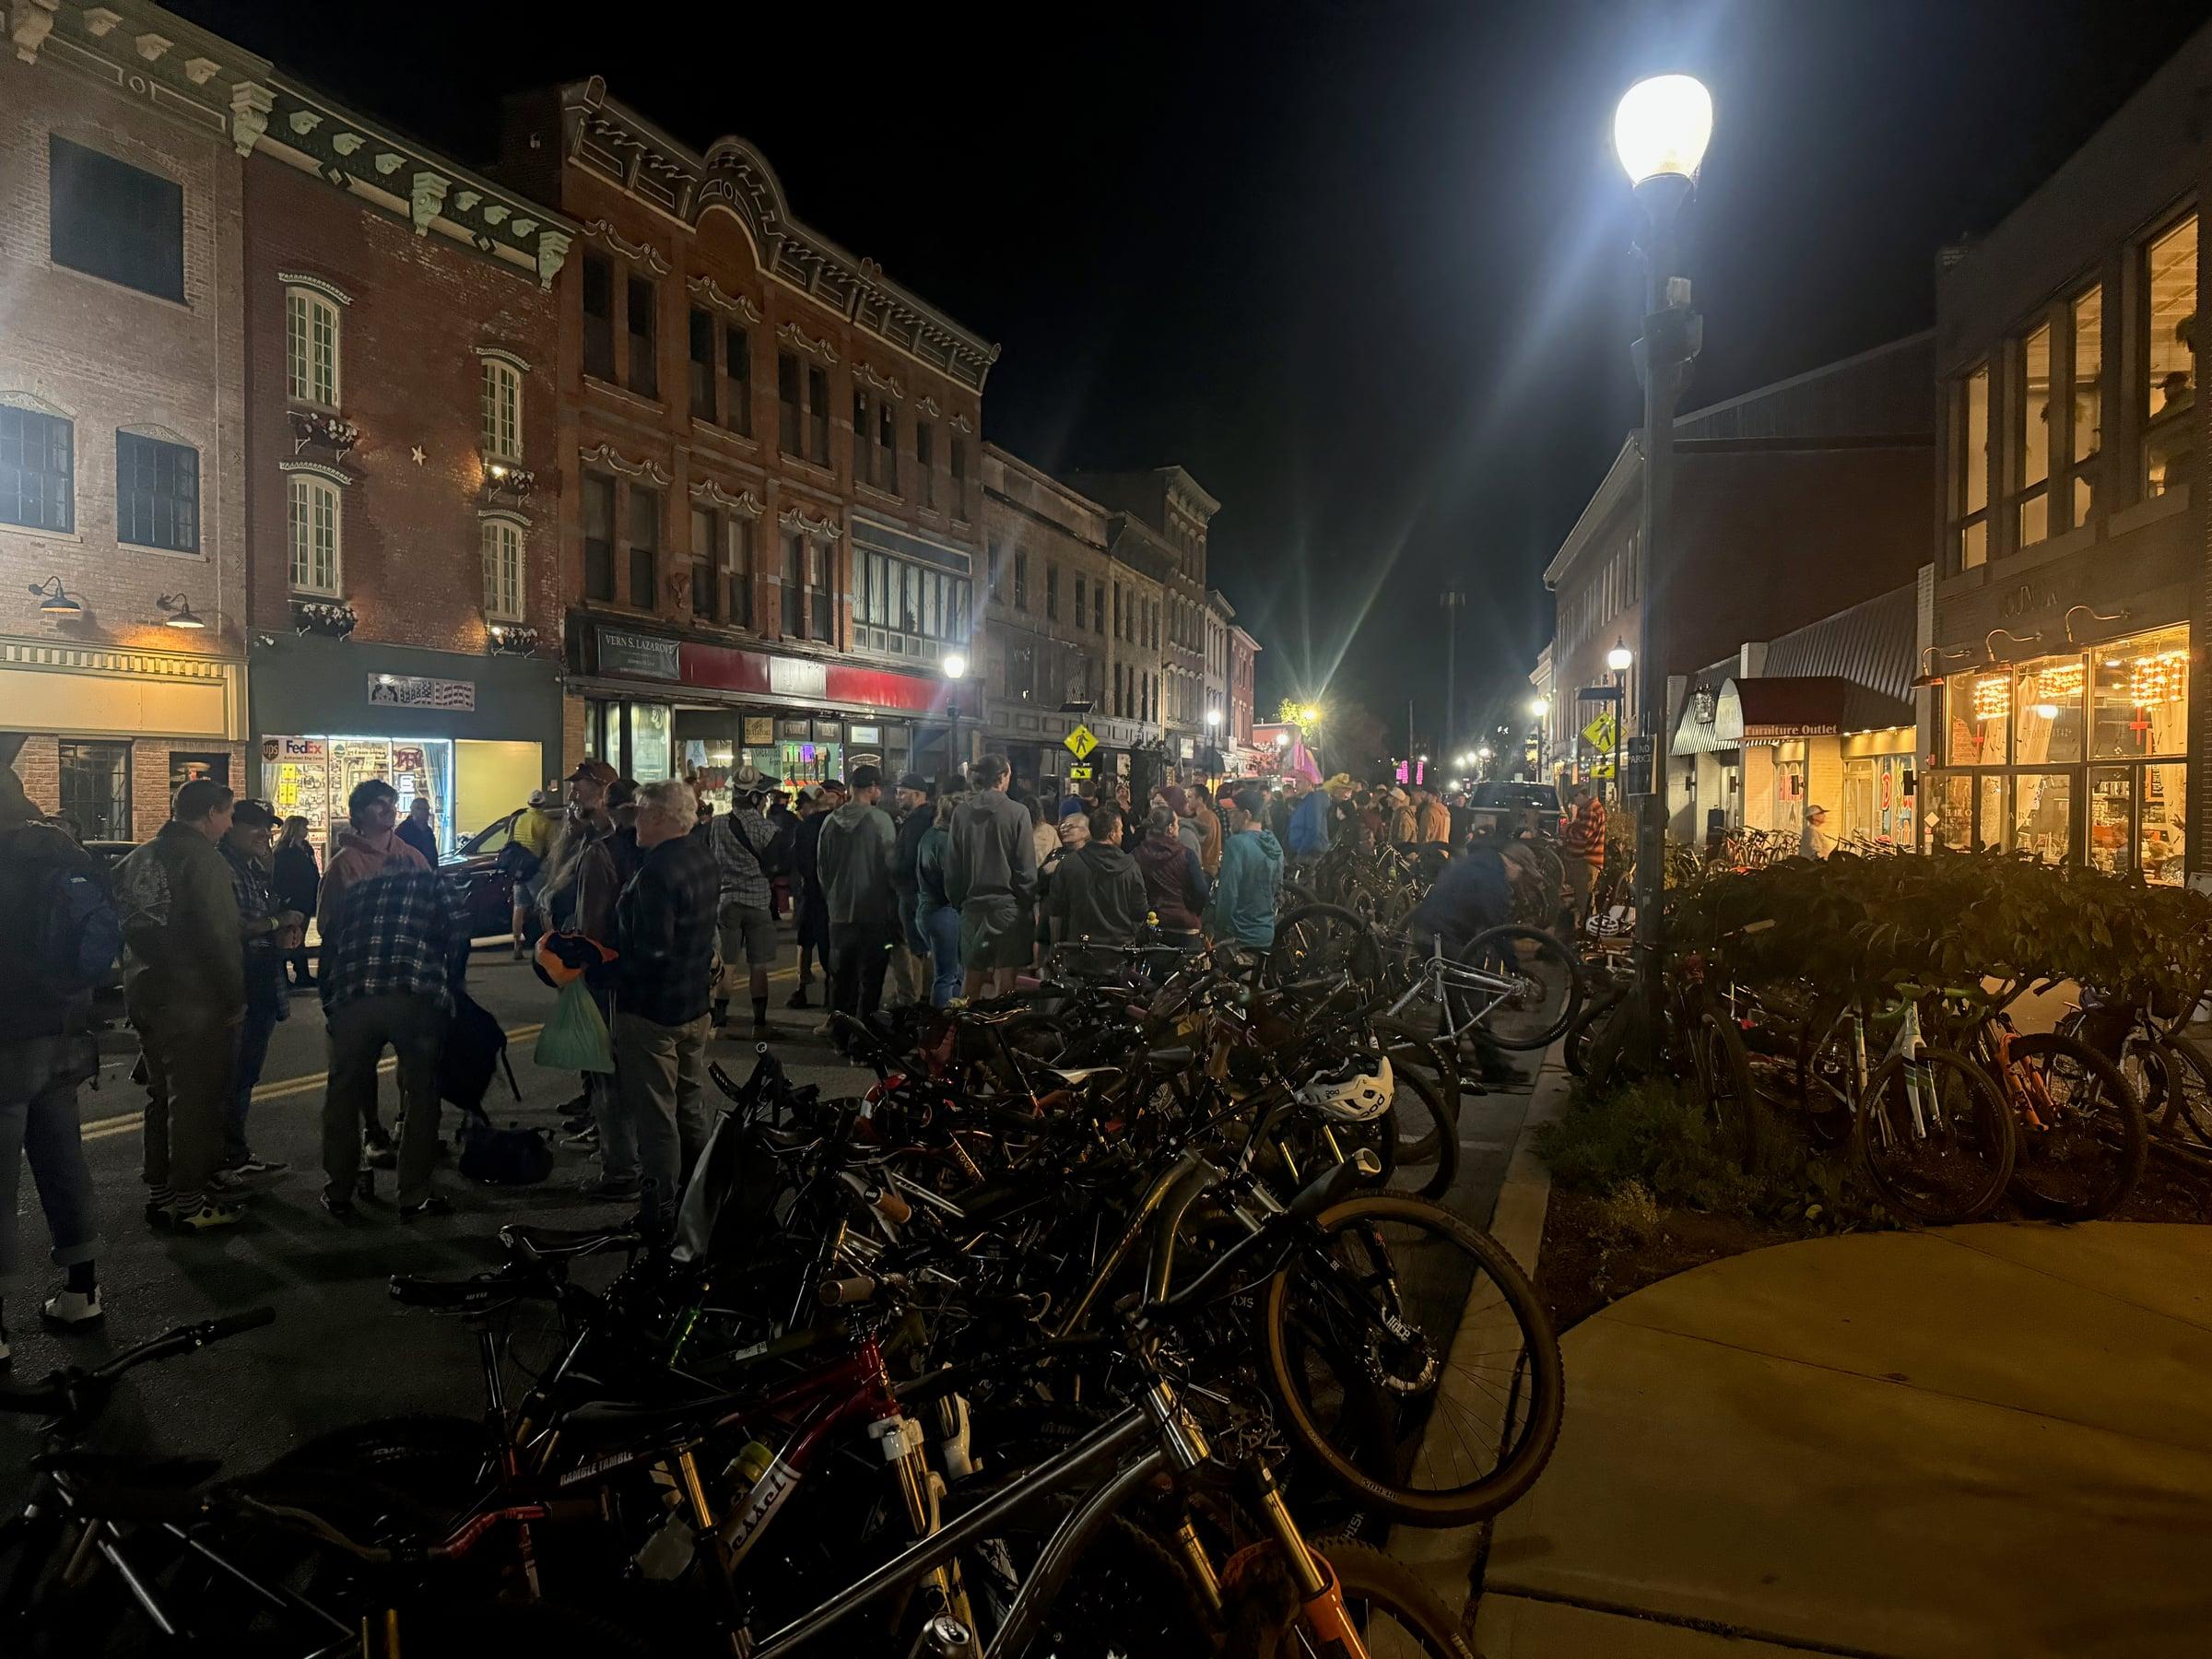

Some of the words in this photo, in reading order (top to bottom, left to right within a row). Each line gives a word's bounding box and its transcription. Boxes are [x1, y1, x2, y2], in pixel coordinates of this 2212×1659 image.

[605, 635, 628, 646] VERN
[629, 637, 635, 648] S.
[1744, 725, 1799, 735] Furniture
[1802, 724, 1838, 735] Outlet
[264, 744, 278, 759] ups
[287, 740, 322, 754] FedEx
[1640, 745, 1650, 753] NO
